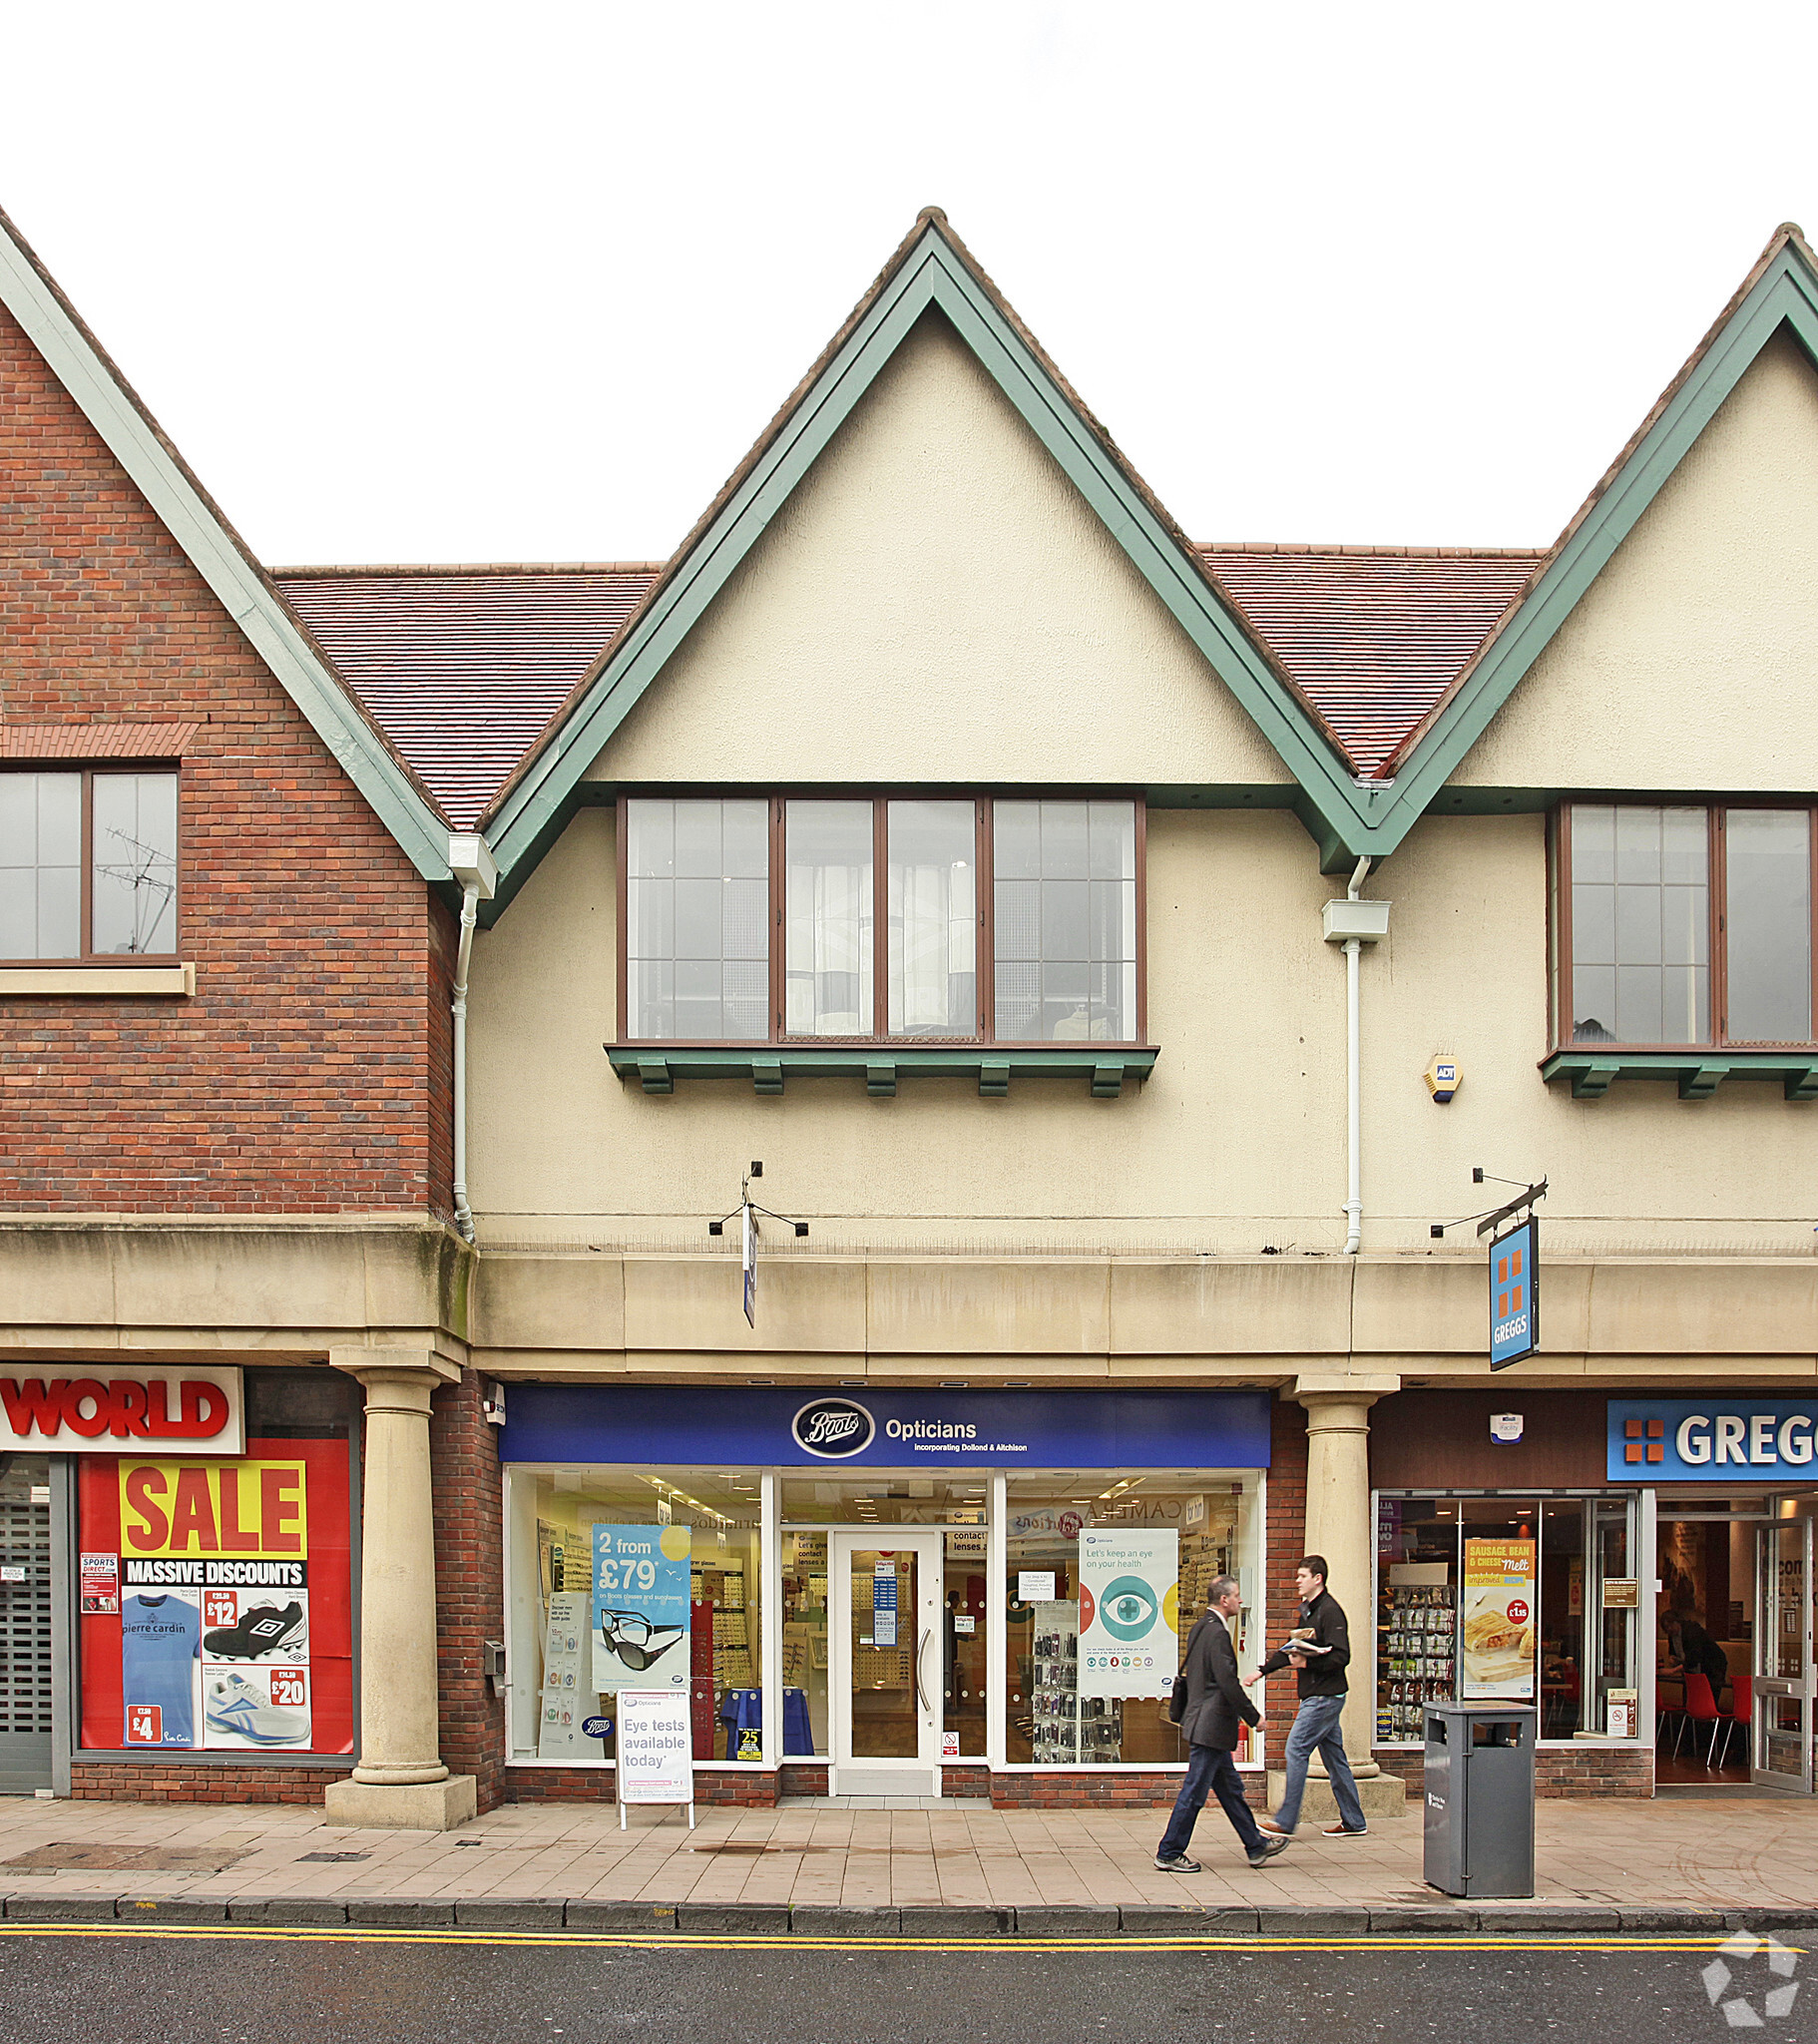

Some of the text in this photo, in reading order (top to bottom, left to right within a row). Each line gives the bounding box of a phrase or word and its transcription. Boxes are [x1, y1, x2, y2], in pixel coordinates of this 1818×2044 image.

[1437, 1066, 1455, 1079] ADT
[1494, 1313, 1527, 1344] GREGGS
[0, 1378, 229, 1437] WORLD
[804, 1412, 860, 1444] Boots
[885, 1418, 977, 1442] Opticians
[1675, 1414, 1818, 1465] GREG
[125, 1465, 301, 1553] SALE
[600, 1532, 612, 1553] 2
[617, 1539, 651, 1554] from
[953, 1542, 982, 1551] lenses
[1087, 1549, 1105, 1558] Let's
[1106, 1549, 1126, 1560] keep
[1138, 1550, 1153, 1560] eye
[1509, 1546, 1530, 1557] BEAN
[1469, 1557, 1530, 1572] & CHEESE Melt
[127, 1561, 302, 1585] MASSIVE DISCOUNTS
[1469, 1577, 1501, 1586] improved
[207, 1601, 235, 1626] £12
[1509, 1606, 1528, 1617] £1.15
[123, 1624, 186, 1634] pierre cardin
[271, 1680, 304, 1705] £20
[133, 1716, 154, 1741] £4
[585, 1719, 611, 1735] Boots
[624, 1719, 685, 1733] Eye tests
[625, 1737, 685, 1749] available
[741, 1731, 758, 1744] 25
